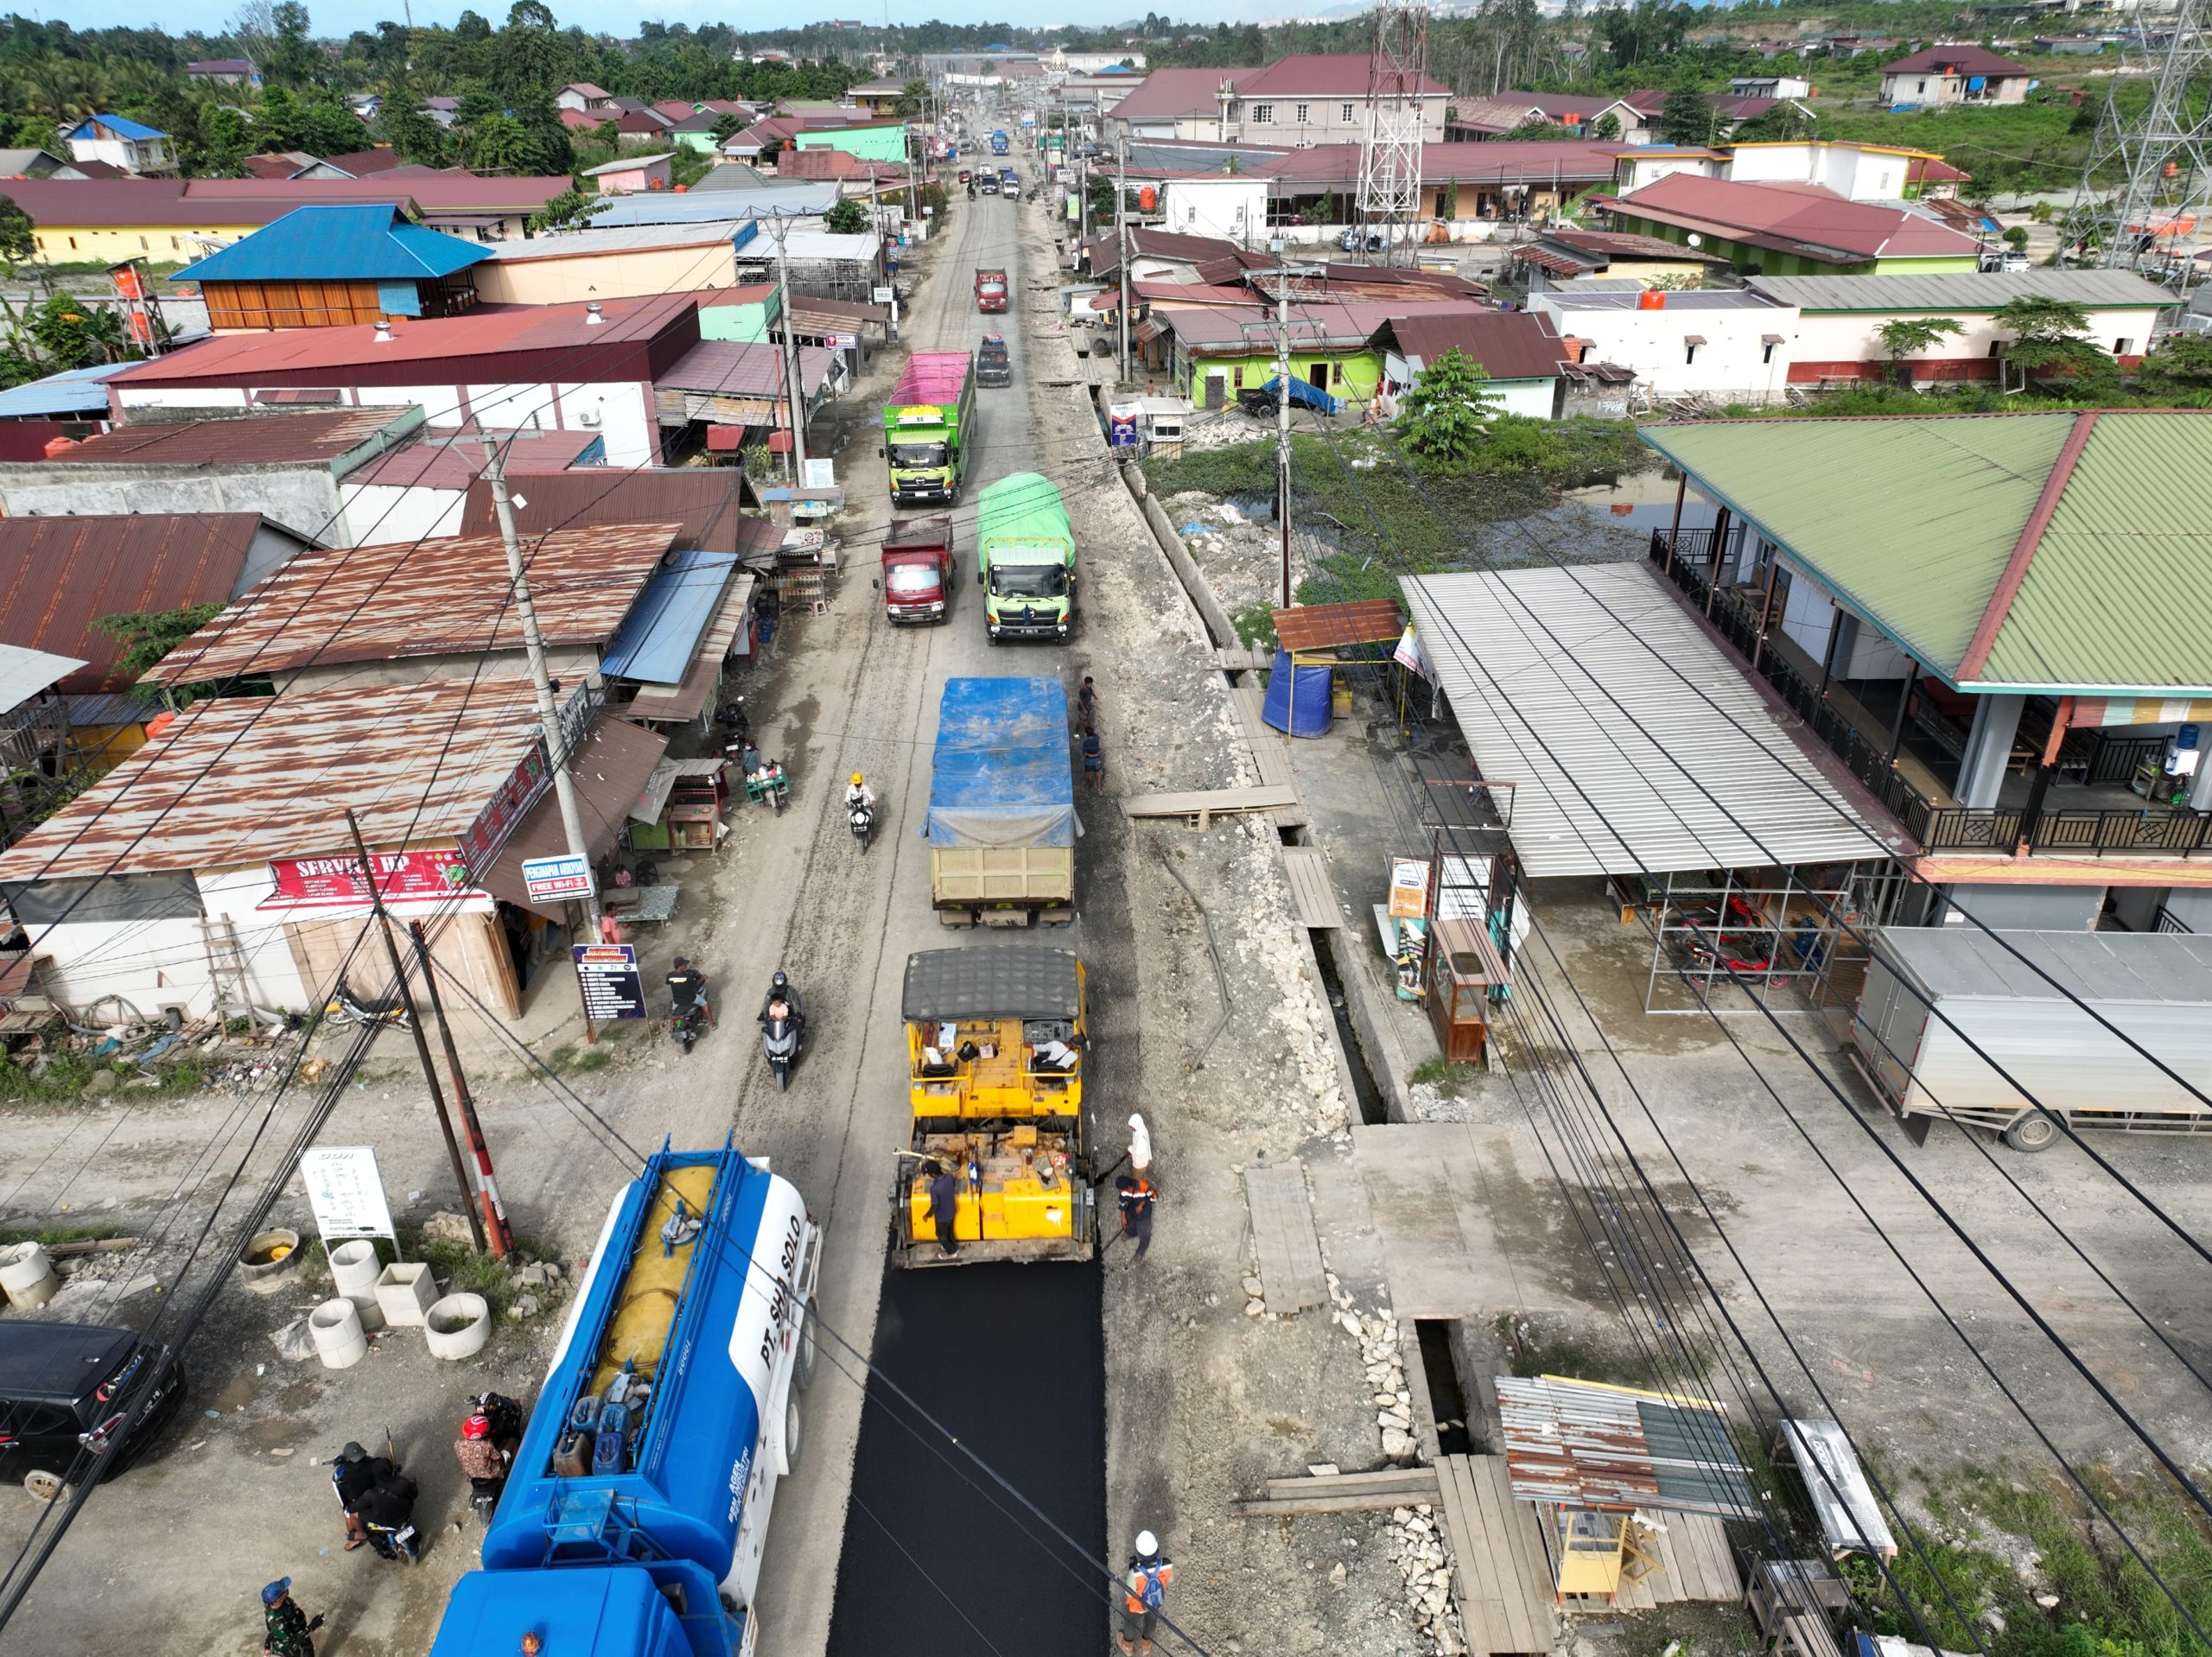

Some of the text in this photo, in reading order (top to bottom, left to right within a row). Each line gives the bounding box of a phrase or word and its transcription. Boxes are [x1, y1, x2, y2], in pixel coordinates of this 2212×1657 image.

[296, 854, 410, 877] SERVICE HP
[524, 863, 560, 880] PENGINAPAN
[531, 882, 553, 892] FREE
[760, 1214, 800, 1372] PT. SHA SOLO
[729, 1458, 741, 1494] AGEN
[733, 1446, 749, 1495] INDUSTRI
[733, 1457, 750, 1524] PERTAMINA
